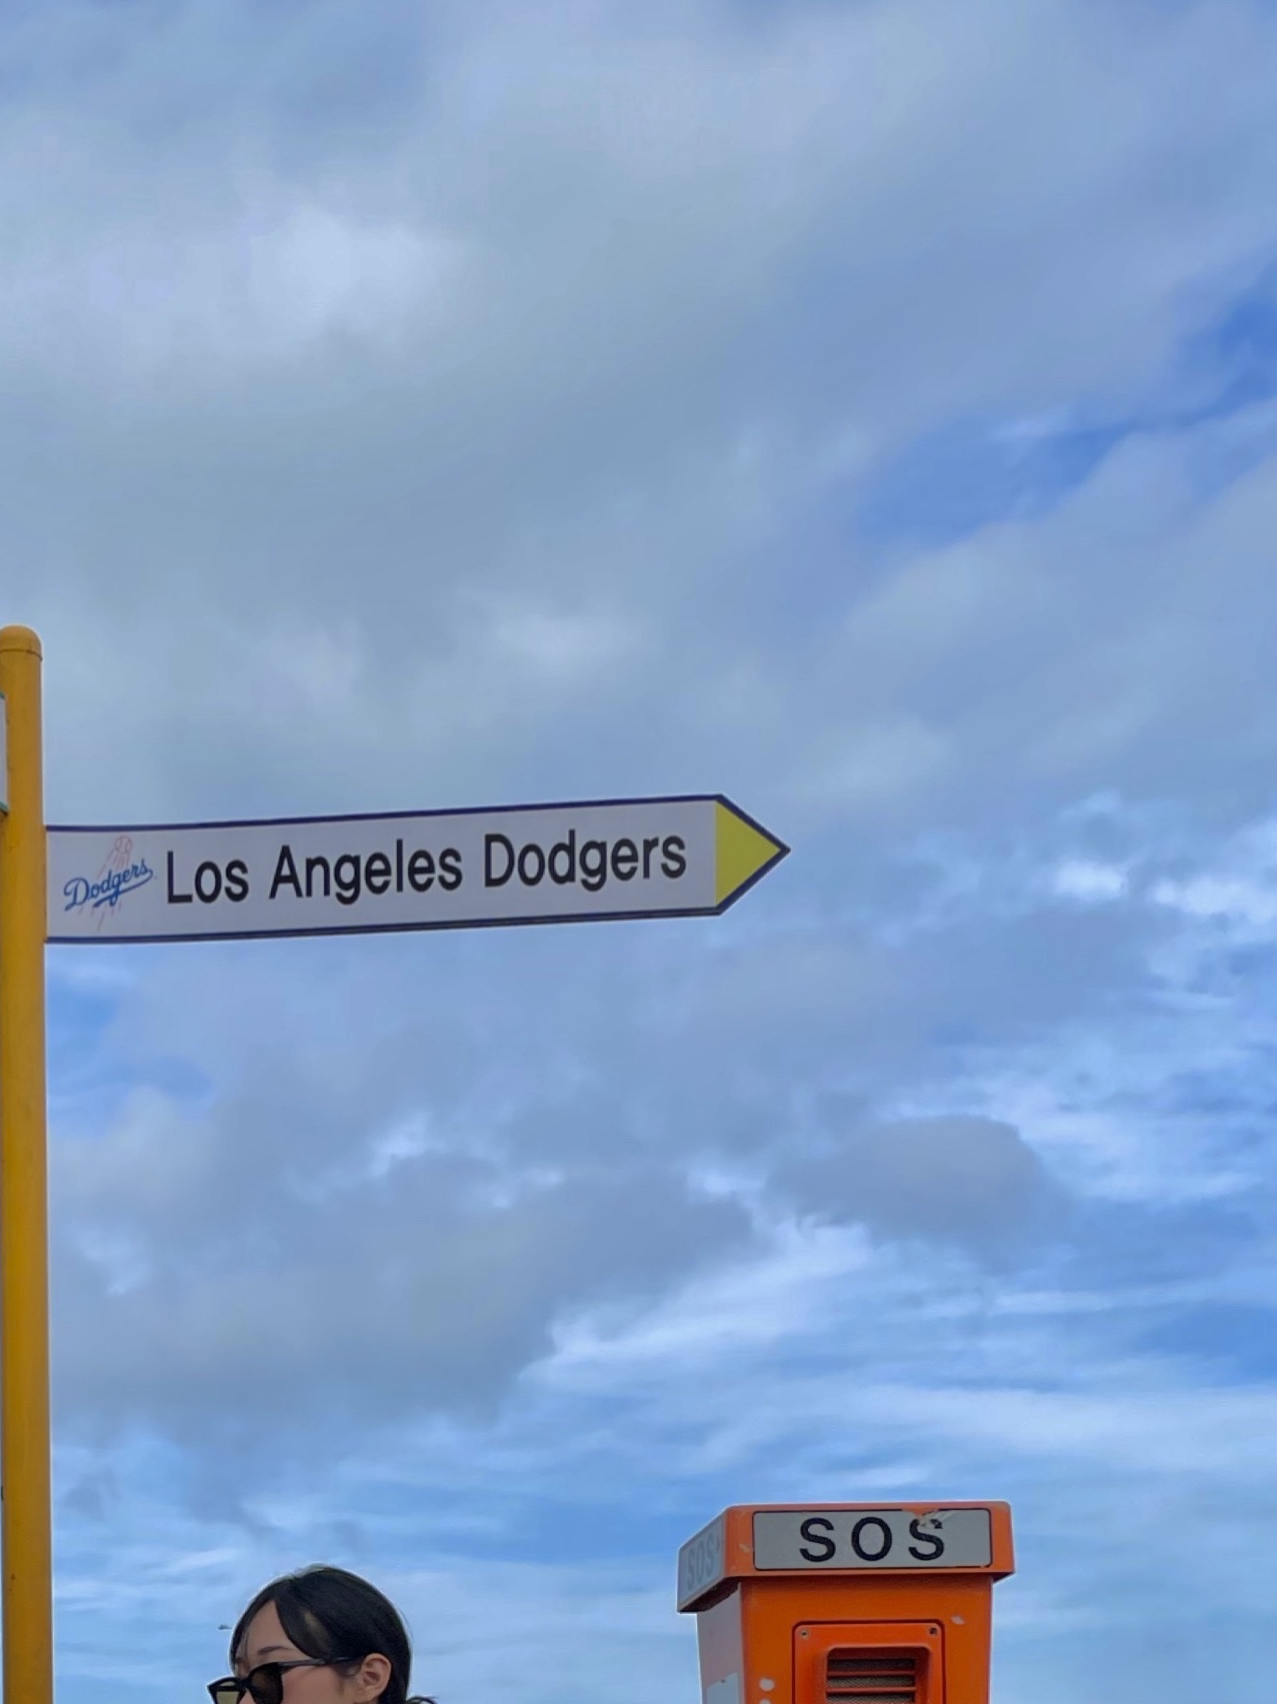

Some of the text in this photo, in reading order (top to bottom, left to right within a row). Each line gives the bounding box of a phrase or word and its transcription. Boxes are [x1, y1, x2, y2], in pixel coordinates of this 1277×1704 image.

[63, 857, 154, 911] Dodgers
[166, 829, 687, 906] Los Angeles Dodgers
[686, 1531, 716, 1592] SOS
[798, 1516, 947, 1562] SOS
